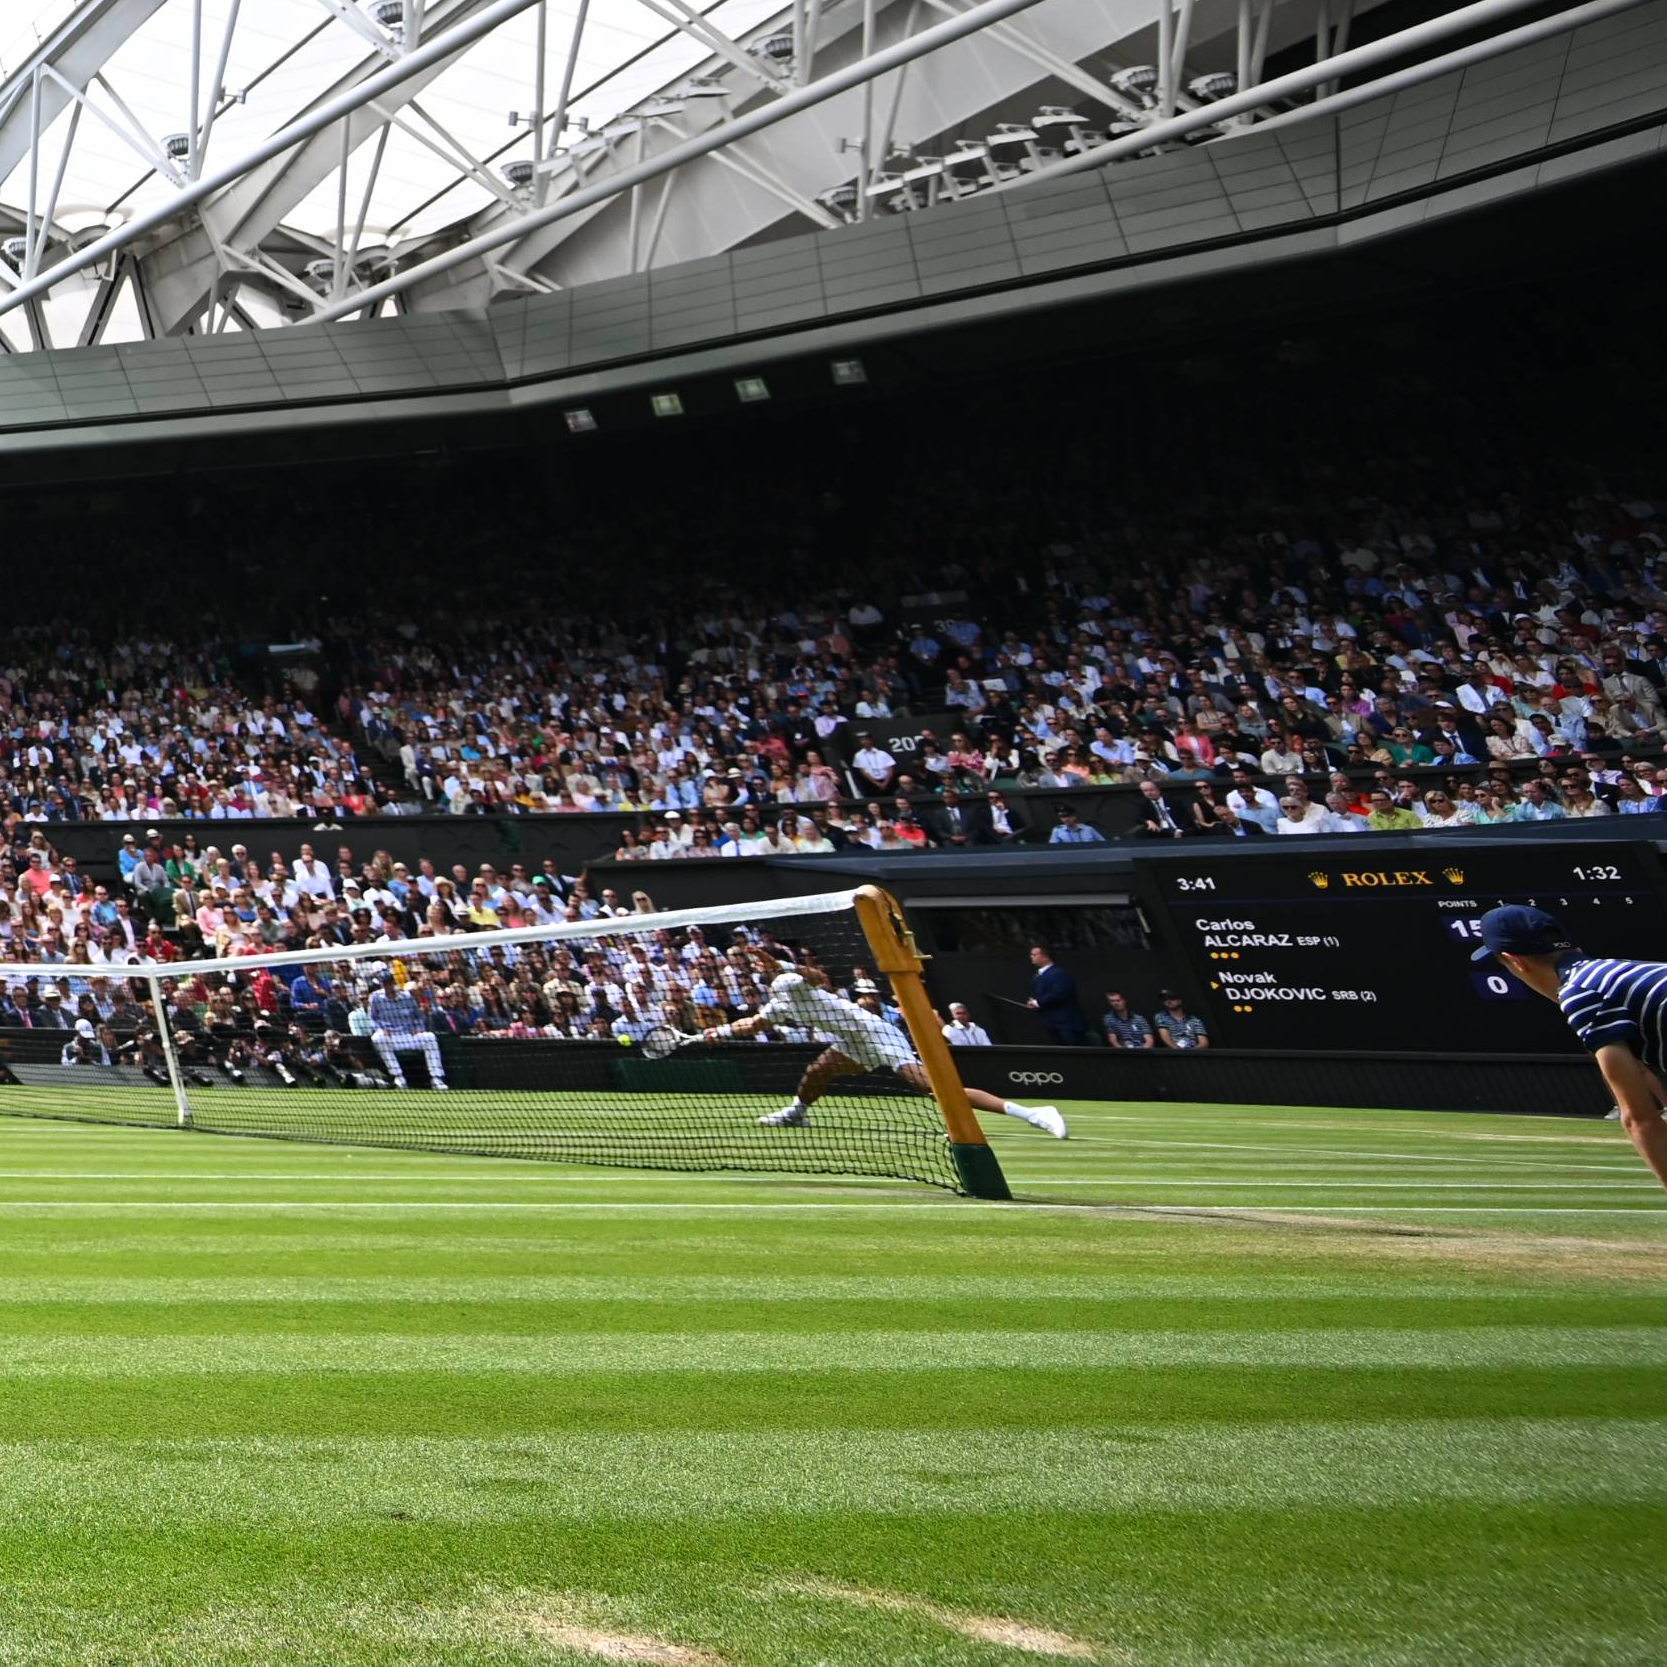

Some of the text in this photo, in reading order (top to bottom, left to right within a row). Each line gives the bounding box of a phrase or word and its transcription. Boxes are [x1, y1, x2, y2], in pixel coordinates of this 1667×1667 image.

[1341, 871, 1433, 887] ROLEX
[1572, 865, 1622, 881] 1:32
[1176, 877, 1216, 891] 3:41
[1437, 900, 1478, 908] POINTS
[1528, 898, 1537, 907] 2
[1559, 897, 1568, 906] 3
[1592, 897, 1601, 905] 4
[1625, 896, 1633, 905] 5
[1195, 918, 1256, 931] Carlos
[1450, 919, 1483, 938] 15
[1204, 934, 1340, 947] ALCARAZ ESP (1)
[1218, 971, 1278, 984] Novak
[1486, 975, 1509, 995] 0
[1224, 987, 1377, 1003] DJOKOVIC SRB (2)
[1008, 1071, 1064, 1086] oppo
